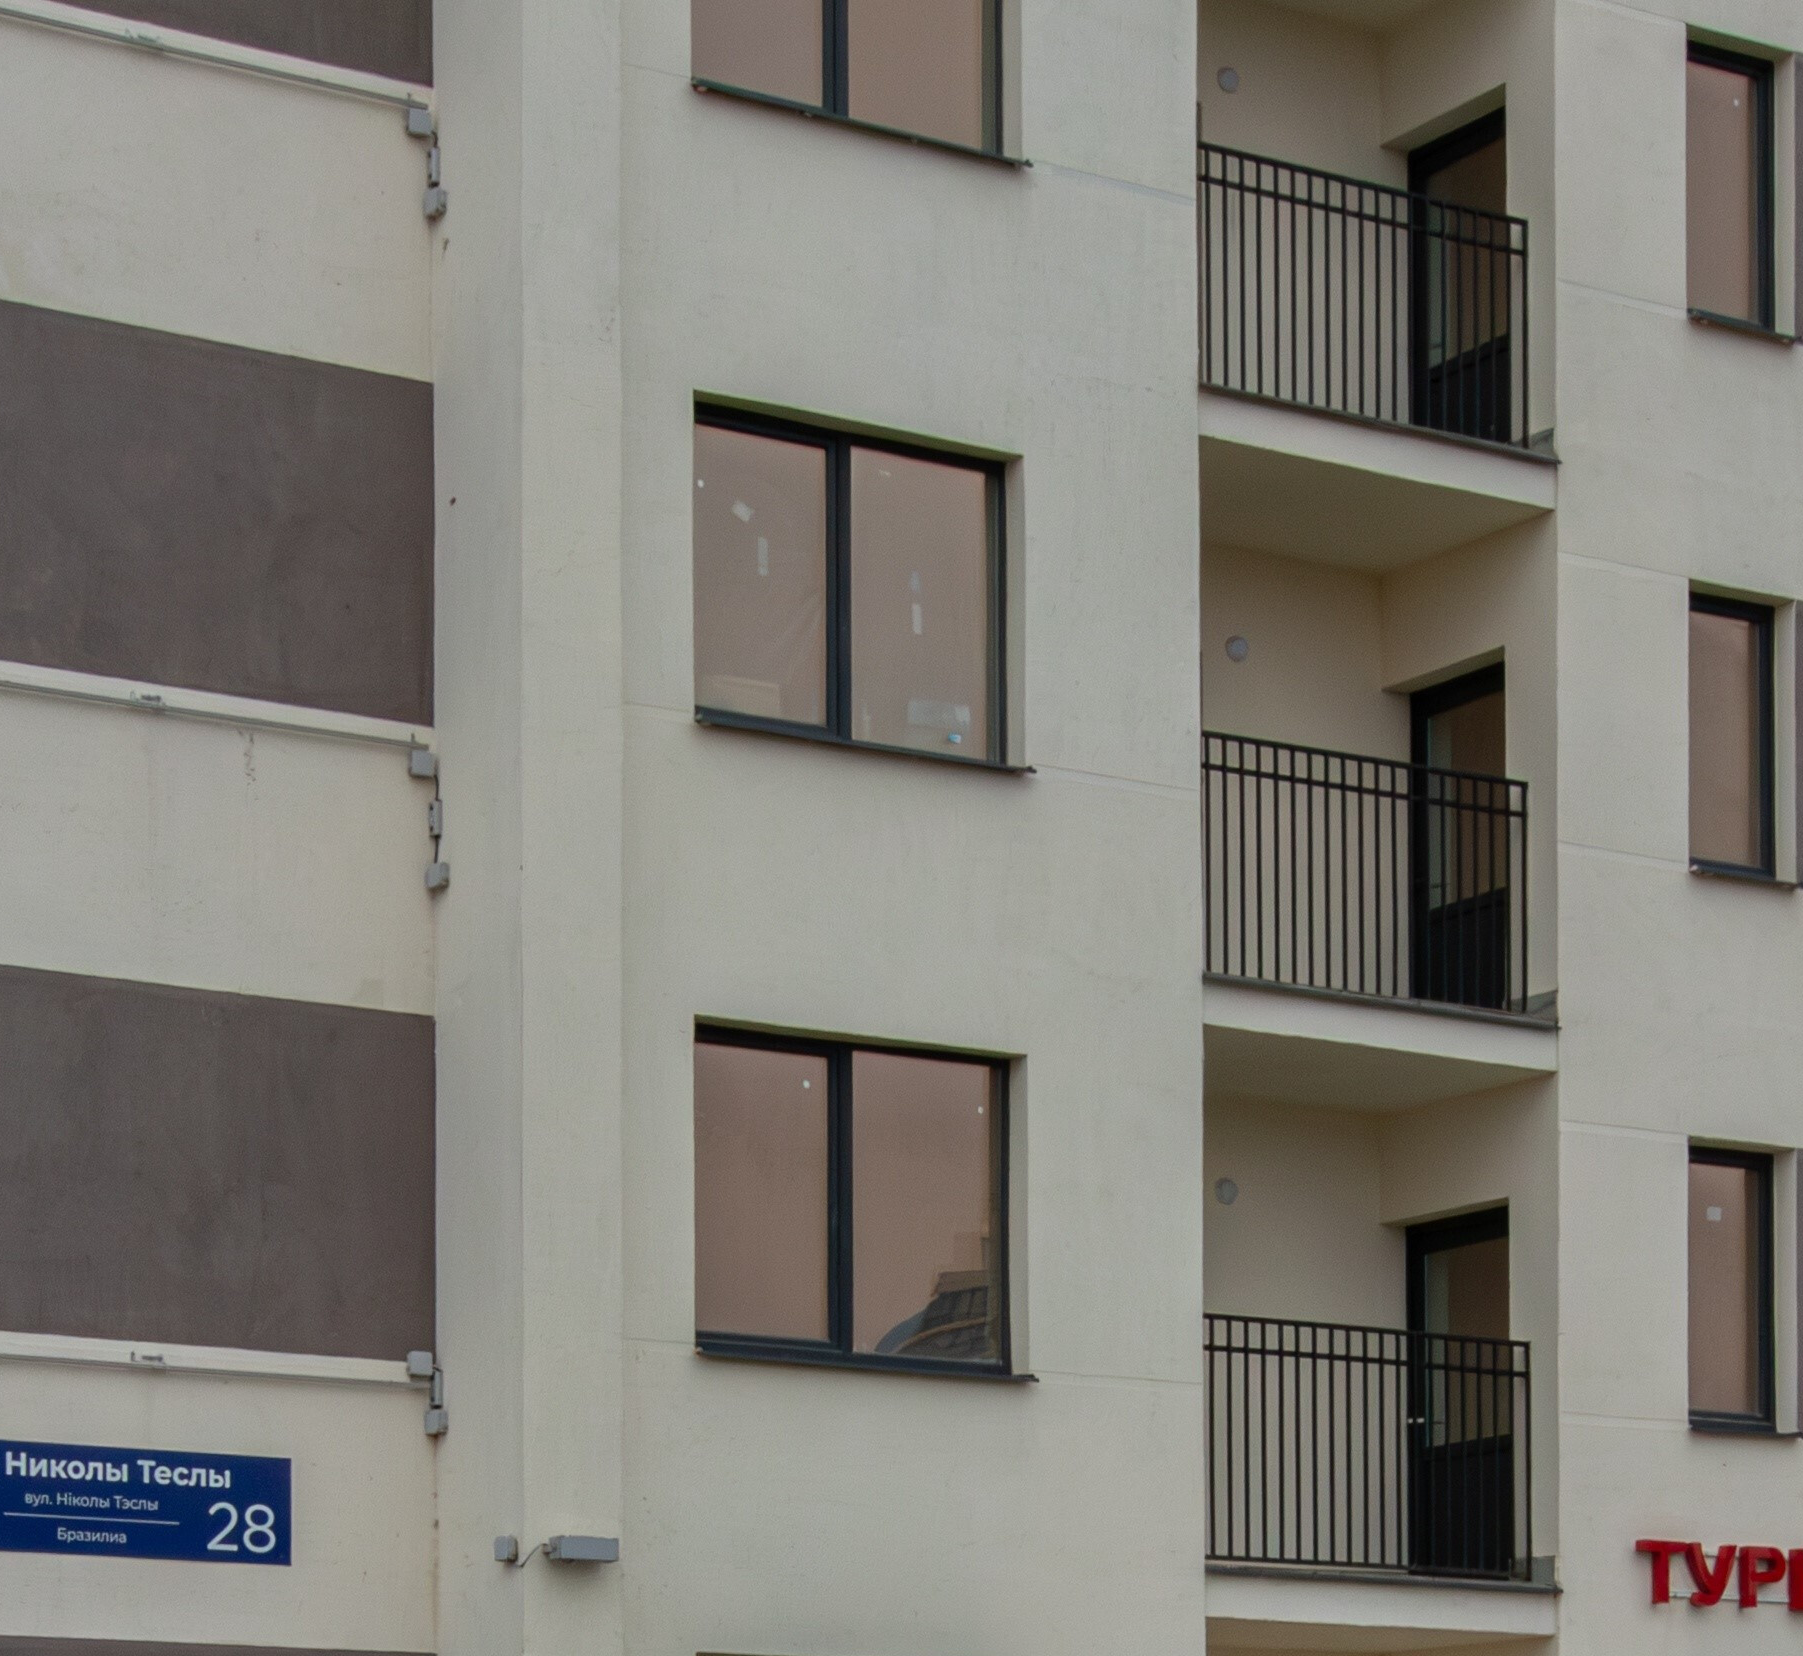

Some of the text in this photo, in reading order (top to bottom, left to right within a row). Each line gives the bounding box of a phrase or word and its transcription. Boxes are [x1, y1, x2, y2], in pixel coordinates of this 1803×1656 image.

[5, 1451, 130, 1483] Николы
[136, 1459, 232, 1489] Теслы
[24, 1492, 159, 1511] вул. Ніколы Тэслы
[57, 1527, 127, 1544] Бразилиа
[206, 1501, 277, 1554] 28
